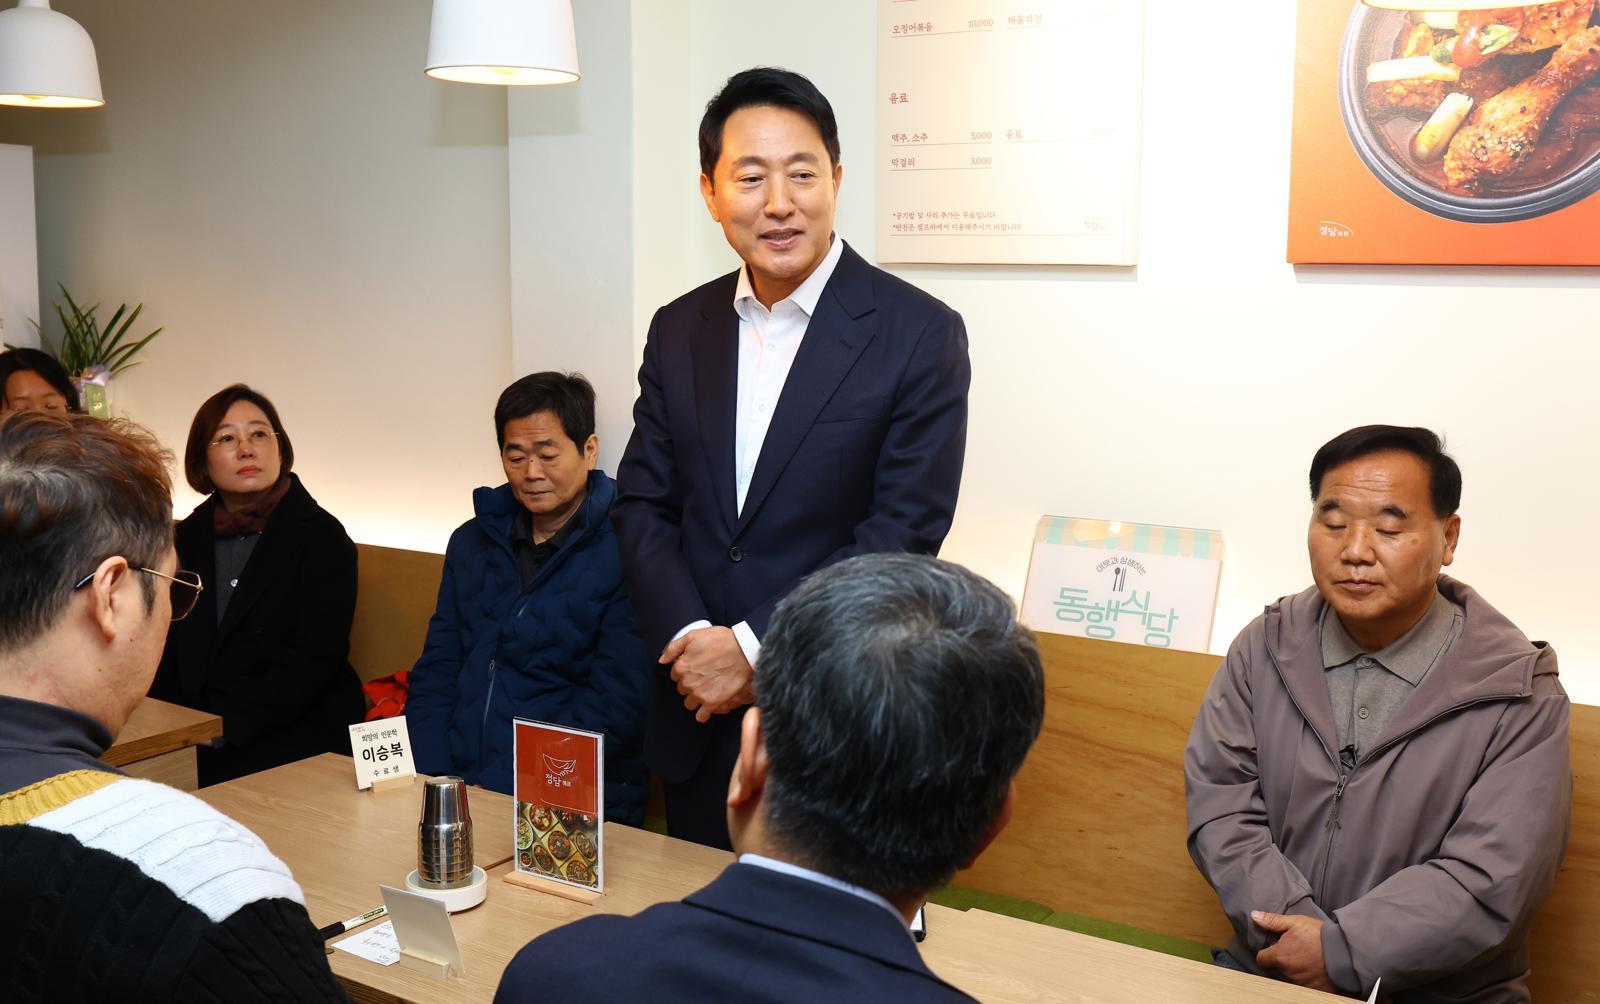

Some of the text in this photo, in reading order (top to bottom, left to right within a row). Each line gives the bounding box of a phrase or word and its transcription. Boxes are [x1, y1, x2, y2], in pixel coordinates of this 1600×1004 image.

[889, 92, 908, 104] 음료
[912, 132, 928, 142] 소주
[970, 131, 992, 140] 5,000
[891, 157, 915, 168] 막걸리
[970, 156, 992, 165] 3,000
[1120, 556, 1147, 577] 상생하는
[1053, 586, 1179, 648] 동행식당
[362, 728, 398, 742] 희망의 인문학
[362, 741, 404, 763] 이승복
[545, 773, 562, 788] 정담
